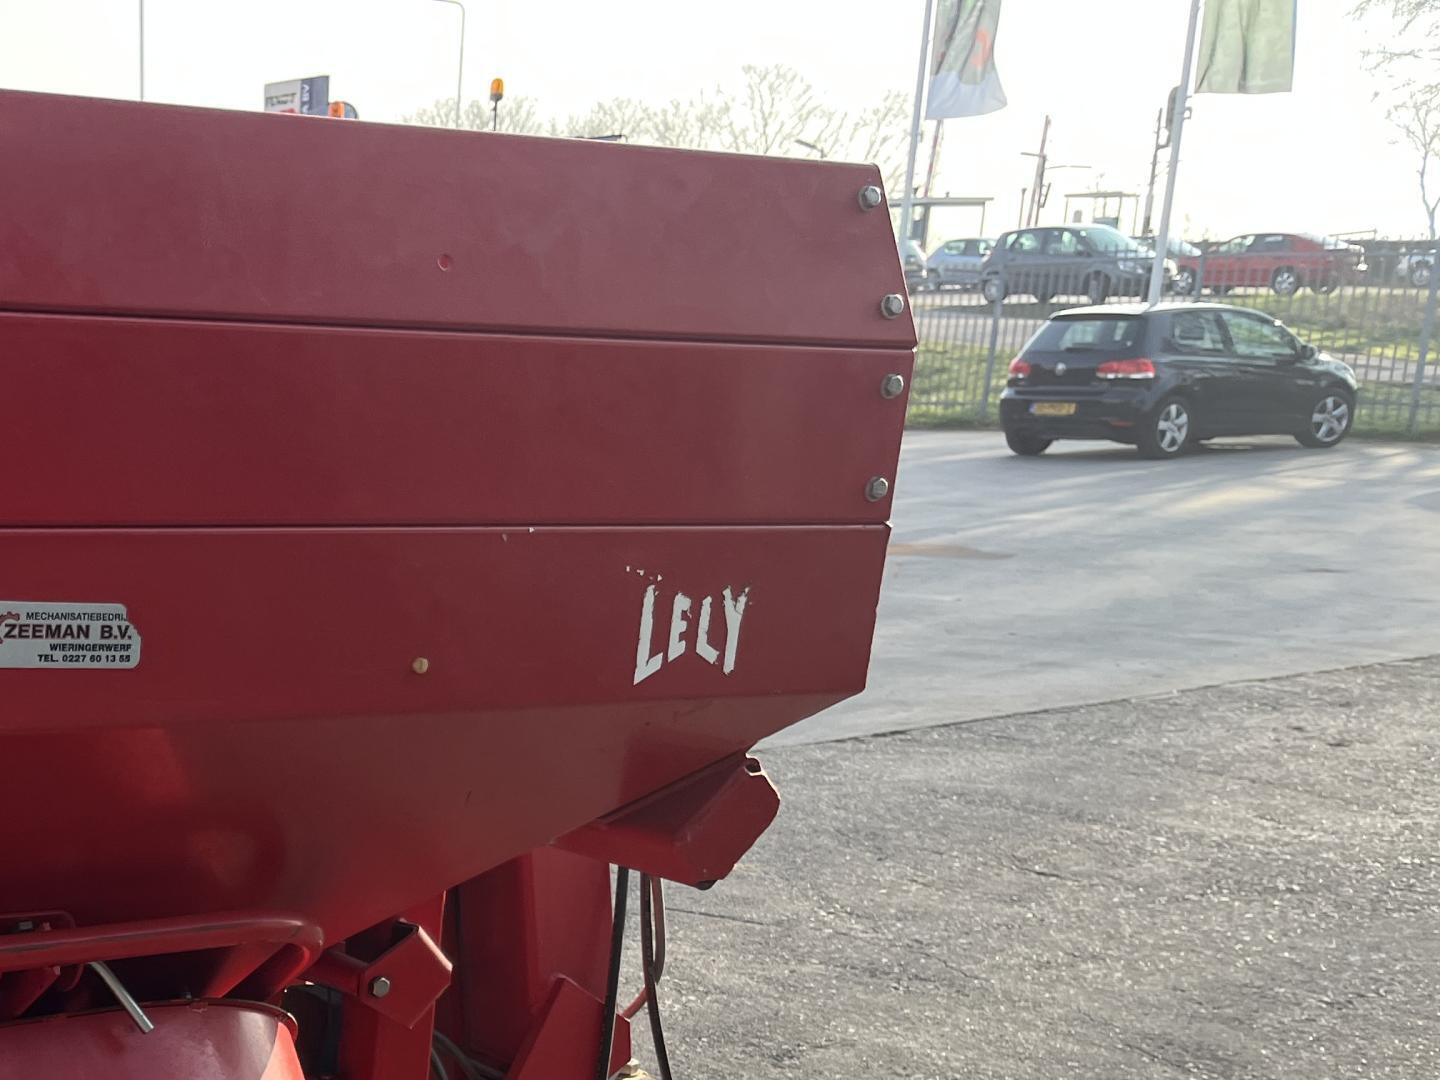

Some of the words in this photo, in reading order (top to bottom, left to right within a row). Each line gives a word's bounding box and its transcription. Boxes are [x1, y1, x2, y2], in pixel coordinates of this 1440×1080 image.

[3, 623, 90, 640] ZEEMAN
[100, 624, 132, 641] B.V.
[633, 584, 750, 686] LELY
[49, 643, 132, 652] WIERINGERWERF
[37, 653, 59, 663] TEL.
[62, 654, 87, 663] 0227
[105, 654, 116, 663] 13
